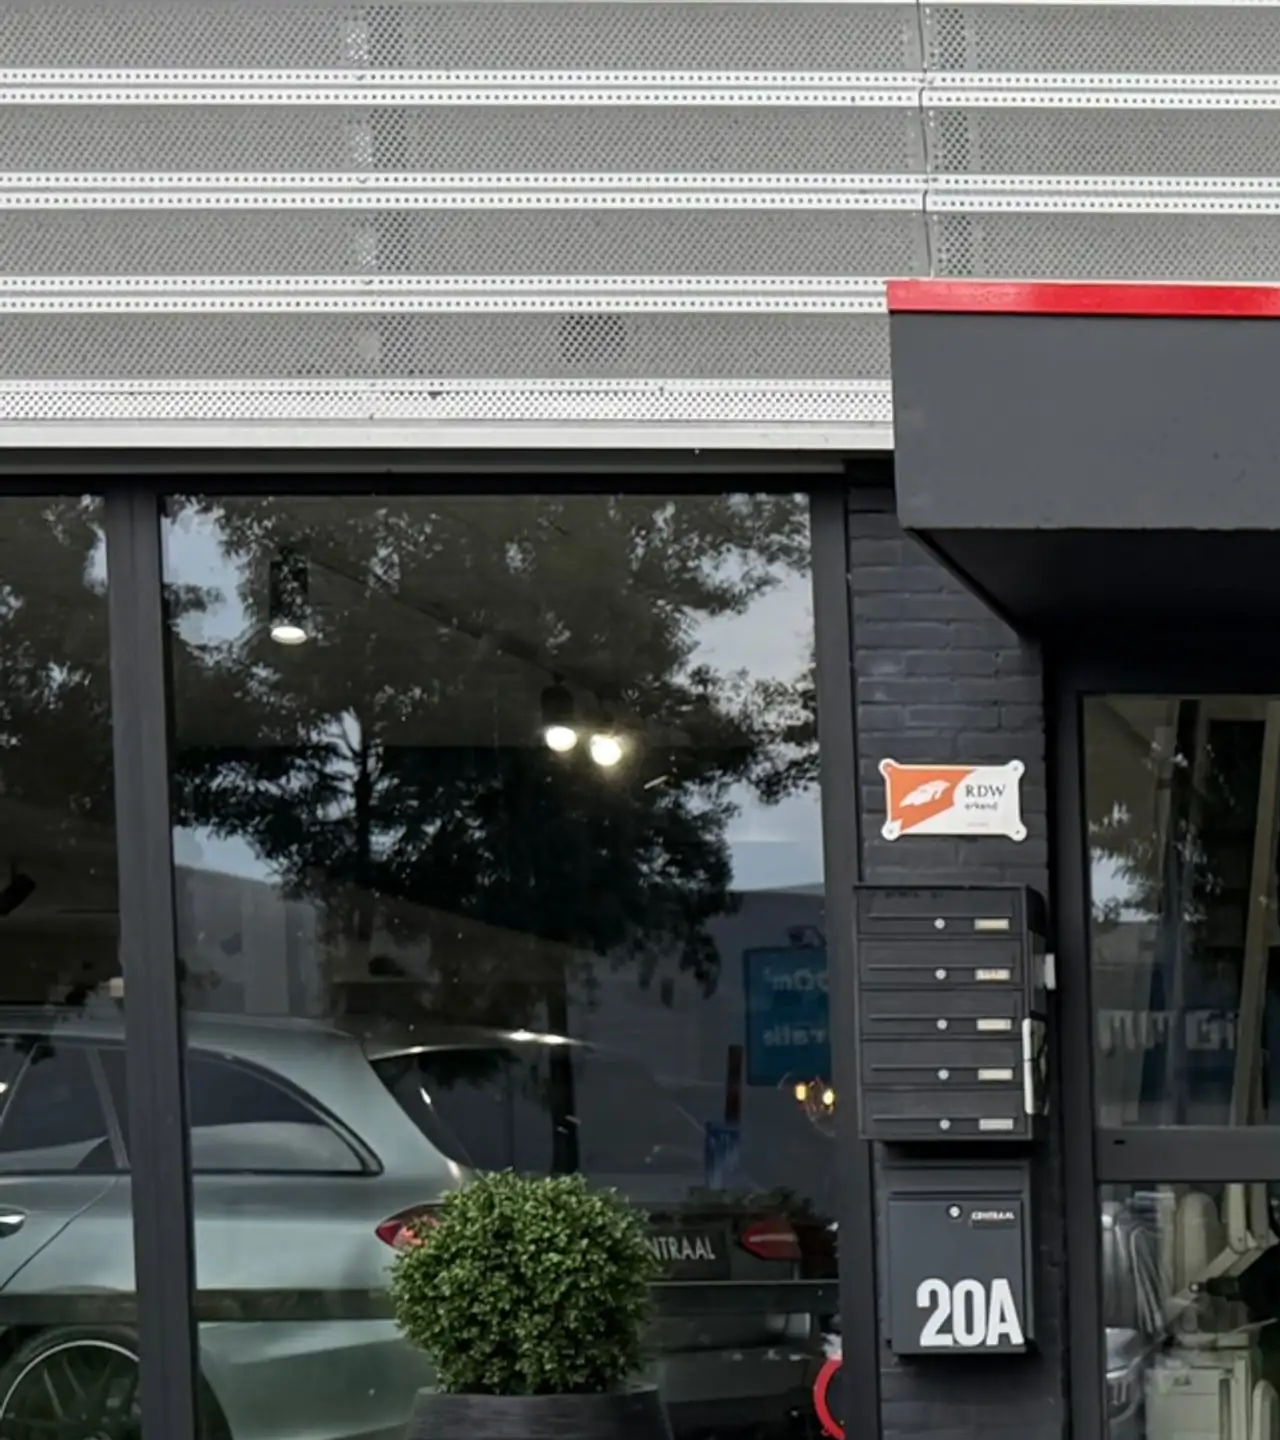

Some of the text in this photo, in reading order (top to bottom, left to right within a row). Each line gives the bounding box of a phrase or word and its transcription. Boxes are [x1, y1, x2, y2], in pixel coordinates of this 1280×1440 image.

[965, 783, 1006, 798] RDW
[644, 1236, 716, 1260] NTRAAL
[916, 1278, 1025, 1347] 20A
